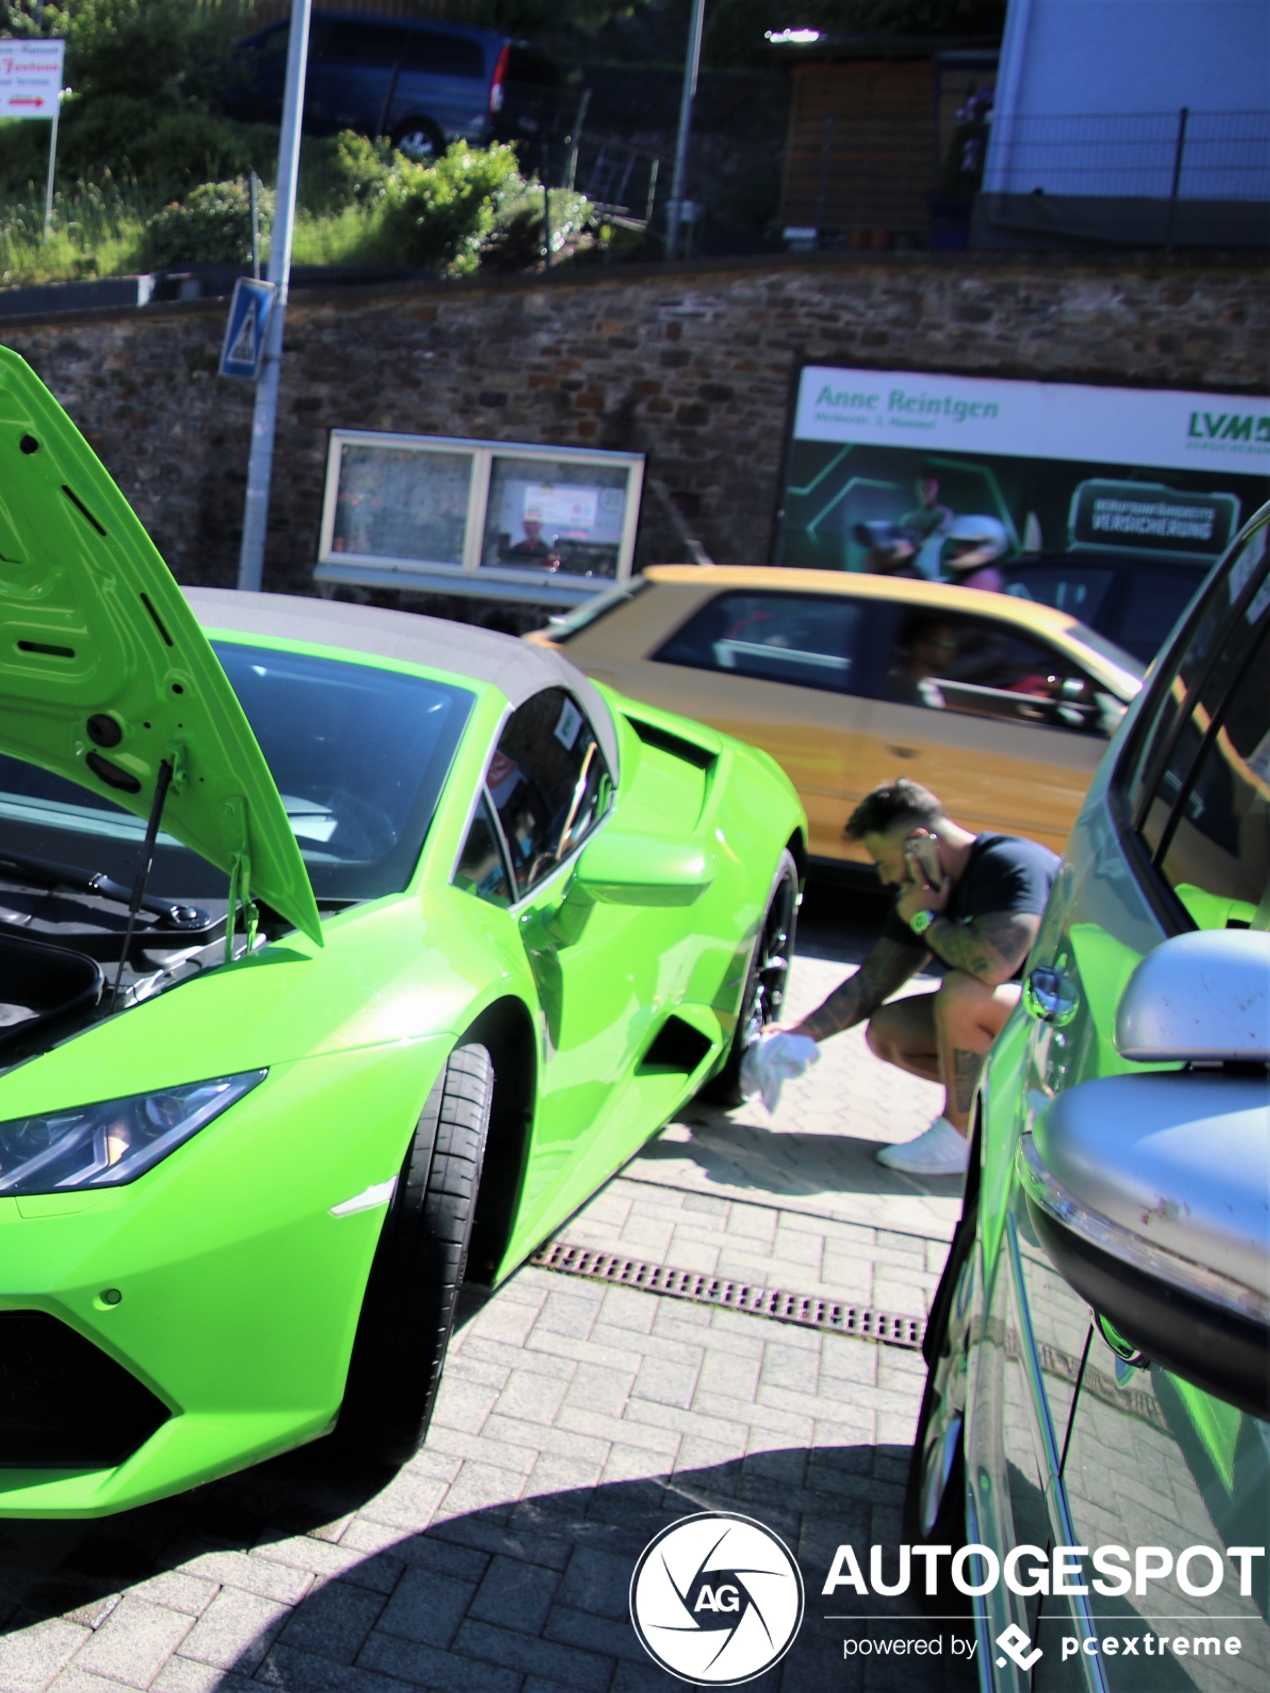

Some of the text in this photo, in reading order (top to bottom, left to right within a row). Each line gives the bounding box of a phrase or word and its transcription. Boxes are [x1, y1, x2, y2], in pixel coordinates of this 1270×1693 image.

[816, 384, 1001, 422] Anne Reintgen
[1092, 514, 1214, 540] VERSICHERUNG
